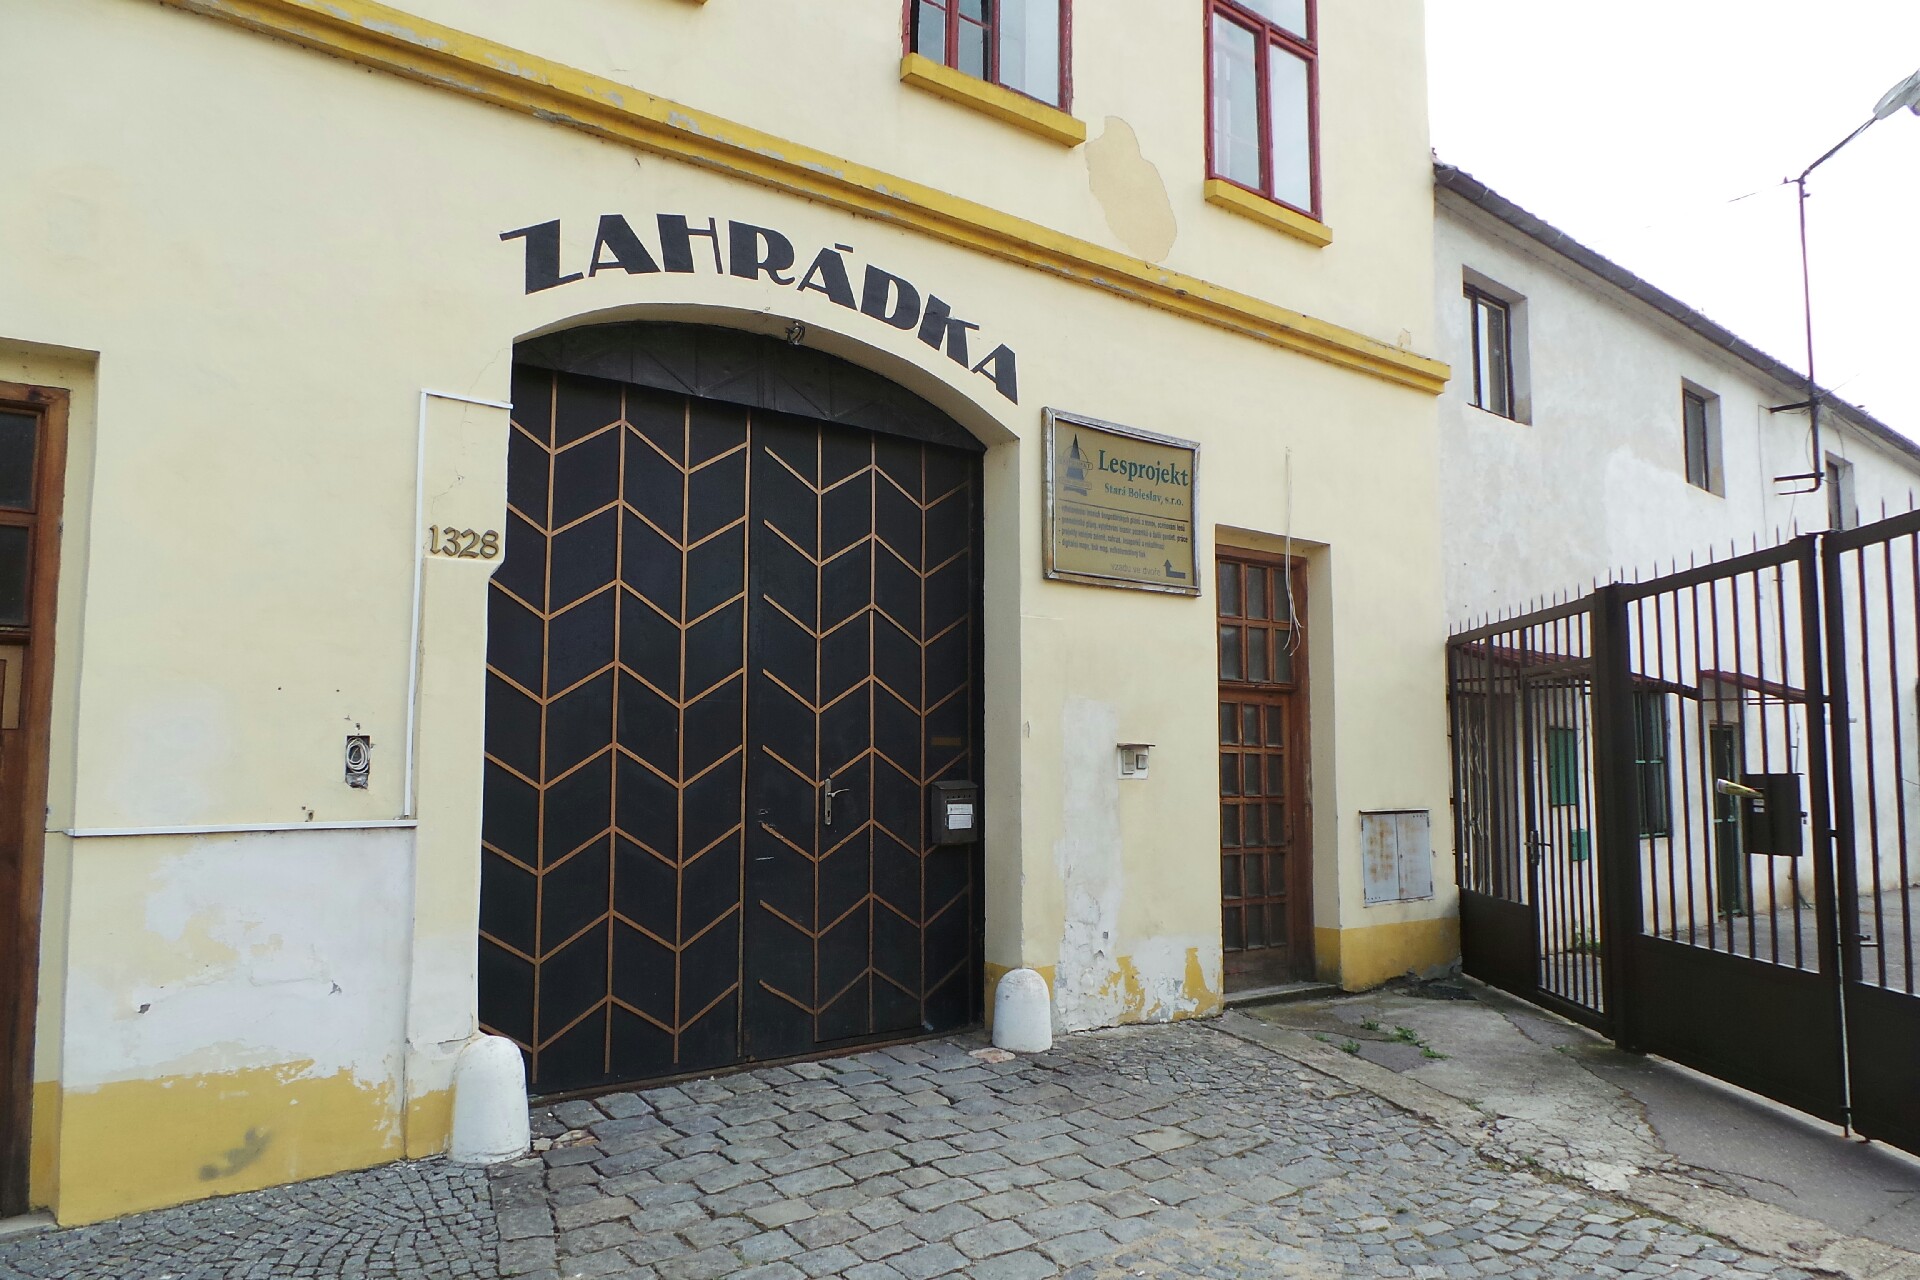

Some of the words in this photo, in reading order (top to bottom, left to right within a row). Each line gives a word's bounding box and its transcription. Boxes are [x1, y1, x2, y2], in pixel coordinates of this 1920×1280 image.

[500, 213, 1018, 405] ZAHRÁDKA
[1098, 449, 1189, 487] Lesprojekt
[1104, 482, 1126, 496] Stará
[1128, 487, 1163, 505] Boleslav,
[1164, 496, 1184, 507] s.r.o.
[429, 524, 500, 559] 1328
